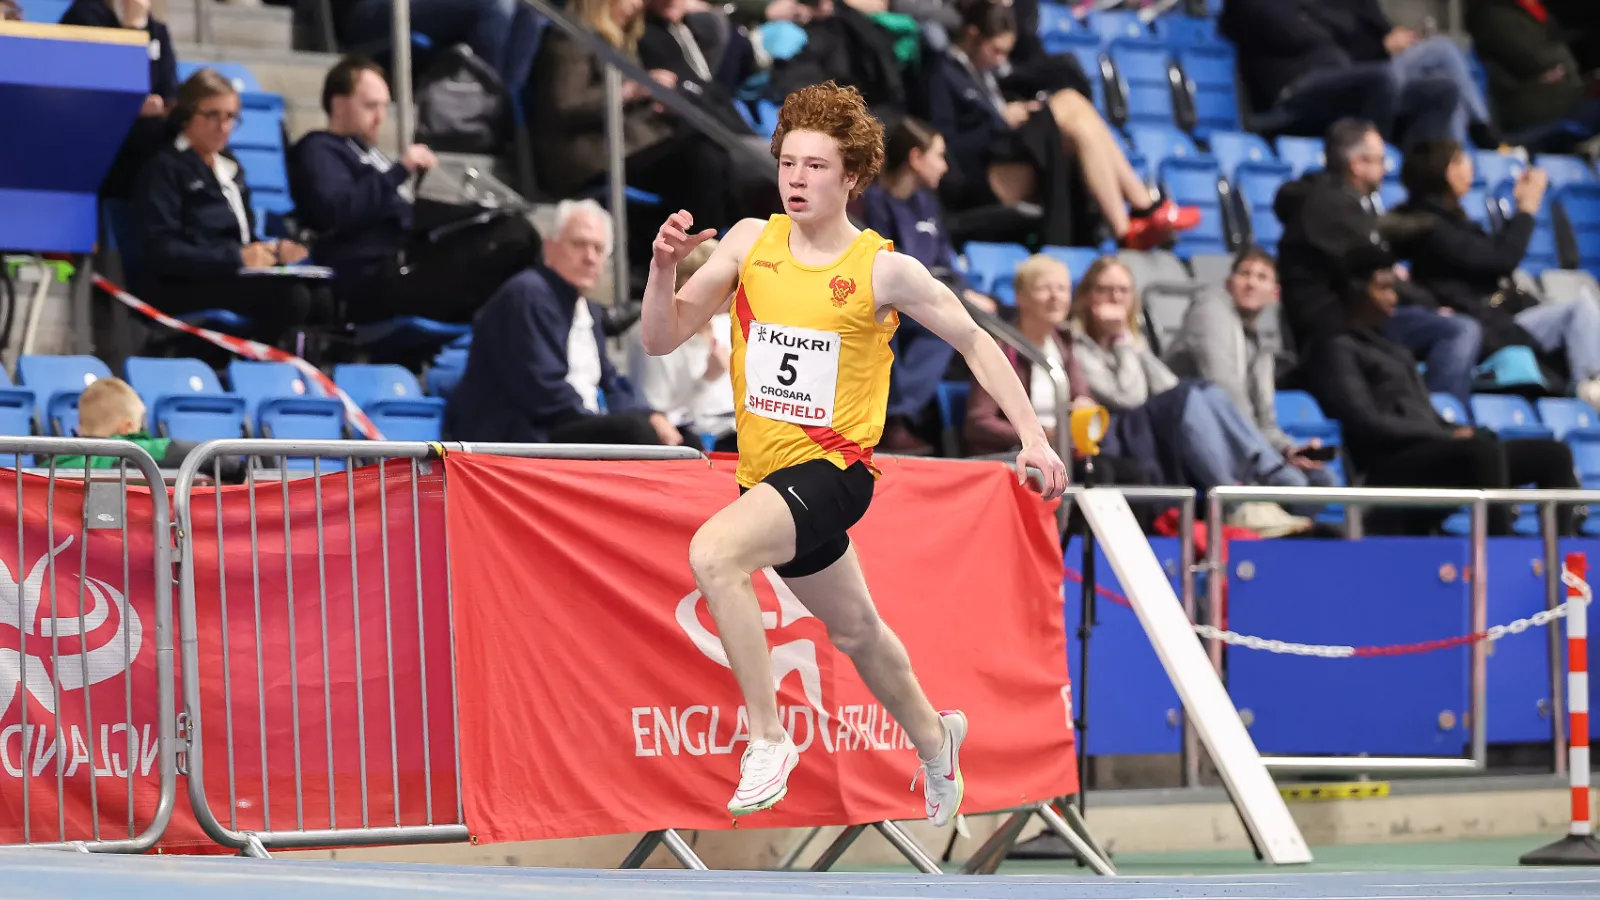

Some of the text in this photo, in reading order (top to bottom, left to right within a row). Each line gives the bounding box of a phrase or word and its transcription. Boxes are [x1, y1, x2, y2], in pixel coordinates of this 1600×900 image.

[770, 330, 830, 352] KUKRI
[777, 352, 799, 386] 5
[760, 385, 812, 402] CROSARA
[749, 395, 826, 420] SHEFFIELD
[631, 705, 815, 757] ENGLAD
